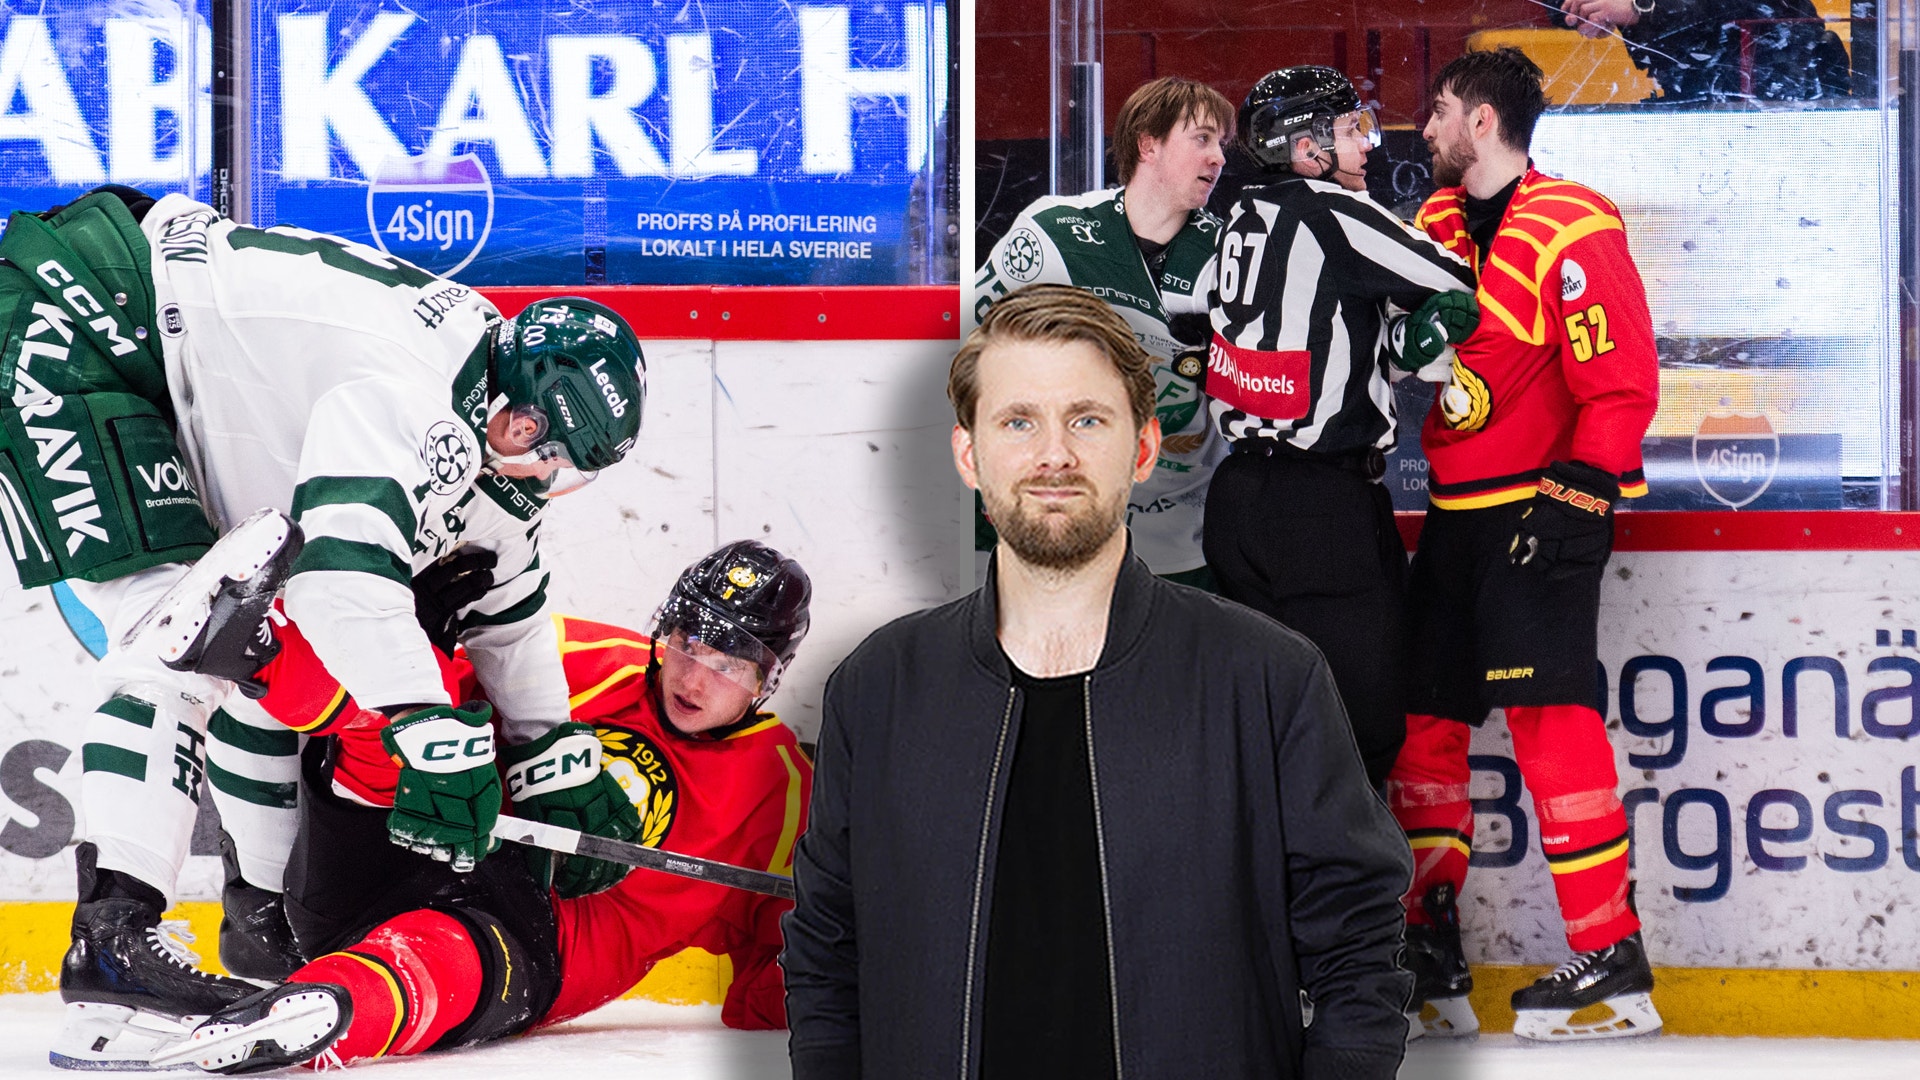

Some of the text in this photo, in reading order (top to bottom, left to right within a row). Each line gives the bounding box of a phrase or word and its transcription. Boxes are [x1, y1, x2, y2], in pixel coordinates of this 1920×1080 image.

[277, 12, 758, 180] KARL
[1284, 112, 1313, 126] CCM
[386, 200, 474, 250] 4Sign
[637, 211, 877, 234] PROFFS PÅ PROFILERING
[641, 239, 872, 260] LOKALT I HELA SVERIGE
[1219, 231, 1268, 305] 67
[36, 259, 138, 357] CCM
[1564, 303, 1616, 363] 52
[588, 357, 629, 418] Lecab
[1240, 370, 1295, 396] Hotels
[11, 301, 110, 558] KLARAVIK
[555, 394, 576, 429] CCM
[1403, 478, 1430, 491] LOK
[1704, 446, 1767, 483] 4Sign
[145, 496, 172, 508] Brand
[1538, 476, 1616, 517] AUER
[1486, 666, 1535, 682] BAUER
[1598, 629, 1920, 770] ganä
[506, 748, 592, 803] CCM
[631, 742, 667, 786] 1912
[1467, 754, 1920, 903] Brgest
